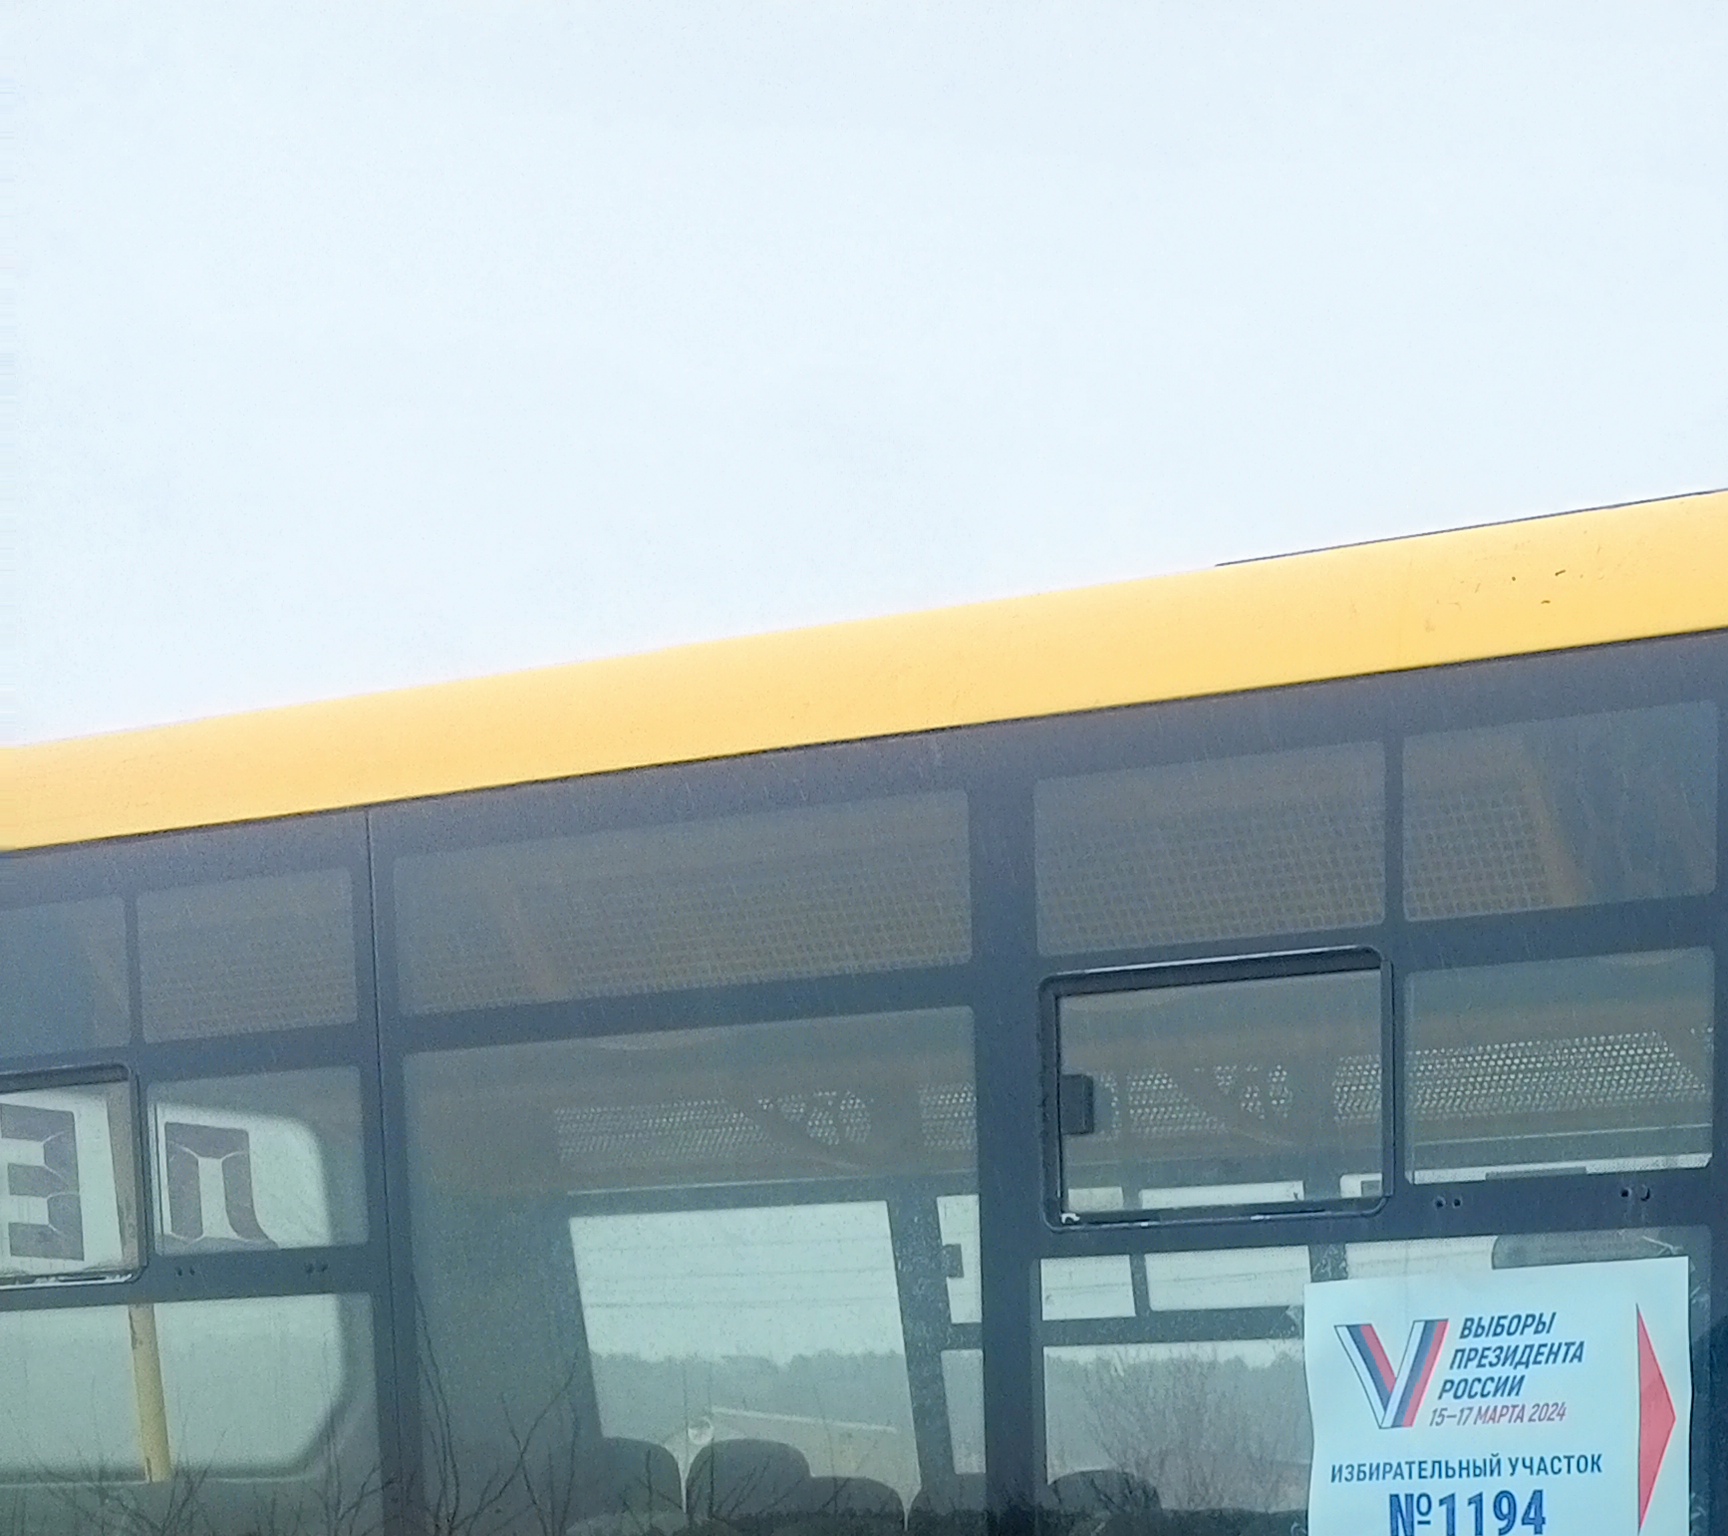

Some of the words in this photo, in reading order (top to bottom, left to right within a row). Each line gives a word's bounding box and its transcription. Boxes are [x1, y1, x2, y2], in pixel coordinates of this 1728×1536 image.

[1458, 1311, 1557, 1341] ВЫБОРЫ
[1448, 1340, 1586, 1371] ПРЕЗИДЕНТА
[1437, 1374, 1526, 1401] РОССИИ
[1473, 1403, 1527, 1425] МАРТА
[1527, 1401, 1567, 1424] 2024
[1330, 1452, 1502, 1484] ИЗБИРАТЕЛЬНЫЙ
[1508, 1452, 1604, 1478] УЧАСТОК
